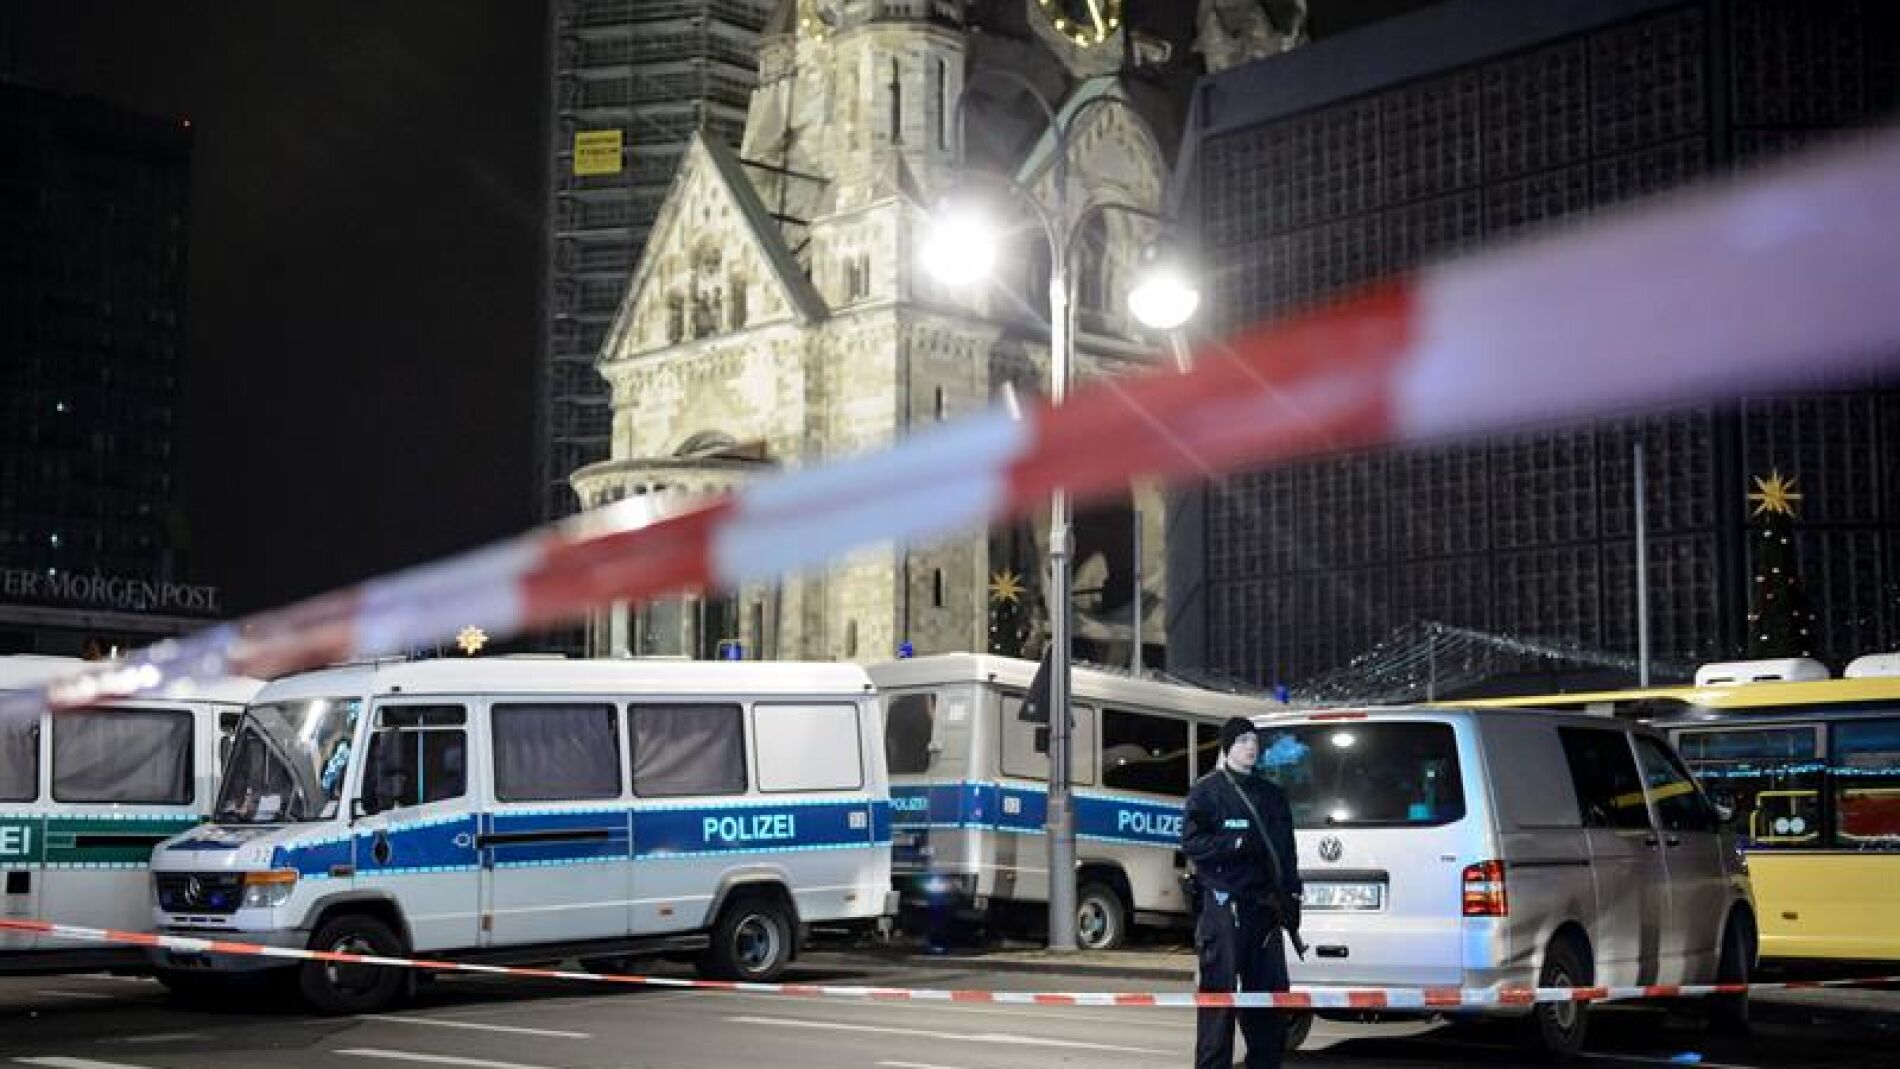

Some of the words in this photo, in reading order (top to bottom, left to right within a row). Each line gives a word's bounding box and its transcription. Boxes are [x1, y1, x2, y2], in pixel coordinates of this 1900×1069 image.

[0, 567, 37, 595] ER
[44, 571, 219, 609] MORGENPOST
[703, 814, 794, 842] POLIZEI
[1118, 810, 1184, 837] POLIZE
